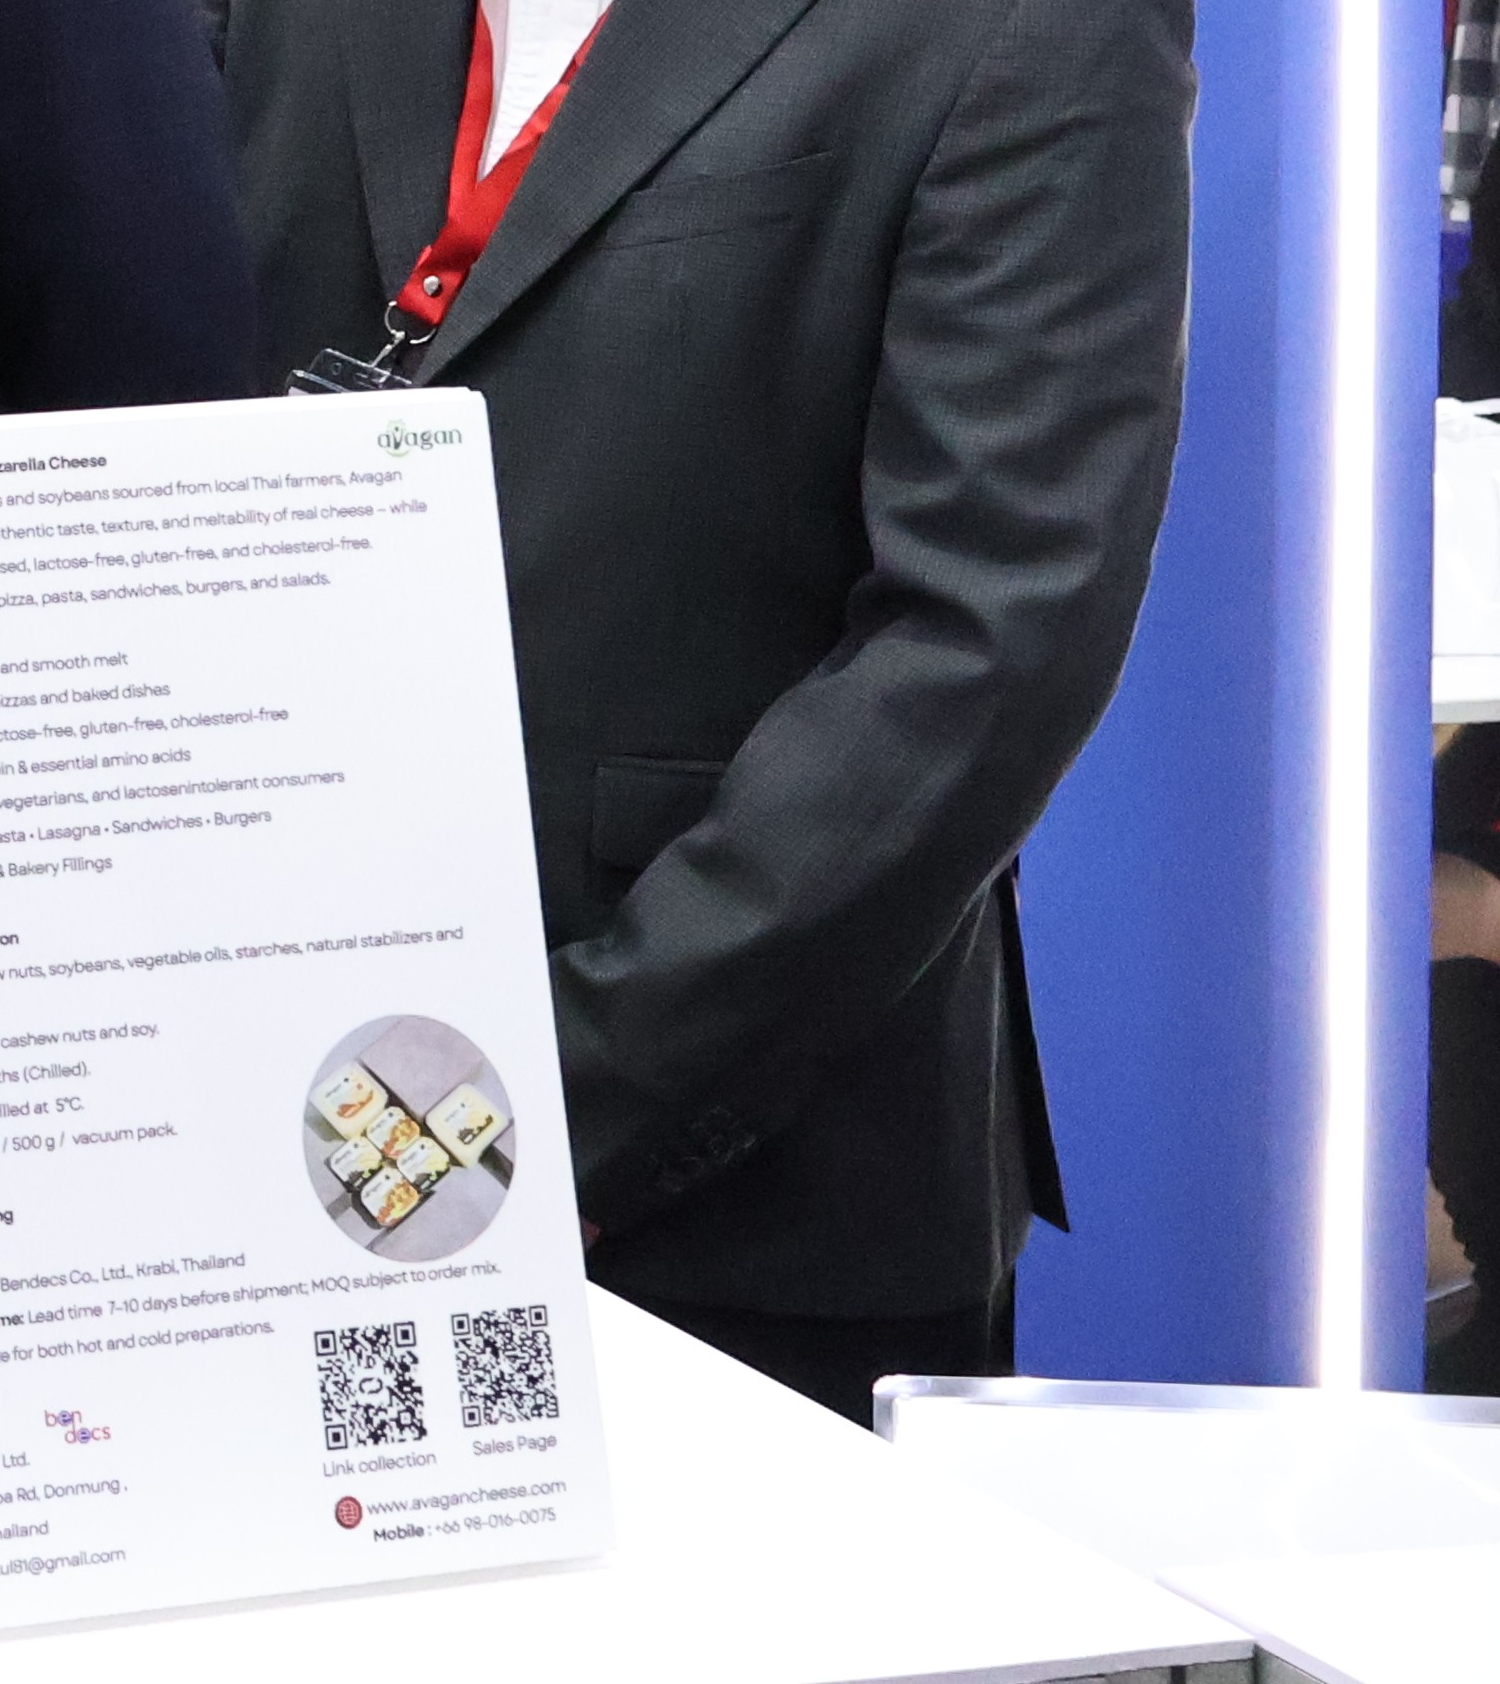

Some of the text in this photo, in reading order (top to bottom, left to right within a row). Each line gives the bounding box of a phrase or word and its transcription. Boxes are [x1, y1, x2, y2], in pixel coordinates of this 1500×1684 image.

[47, 453, 108, 469] Cheese
[39, 689, 69, 705] and
[71, 686, 120, 702] baked
[120, 682, 171, 698] dishes
[0, 1030, 60, 1048] cashew
[61, 1028, 97, 1043] nuts
[98, 1023, 129, 1040] and
[130, 1023, 160, 1040] soy.
[472, 1431, 558, 1455] Sales Page
[322, 1451, 437, 1478] Link collection
[366, 1479, 567, 1518] www.avagancheese.com
